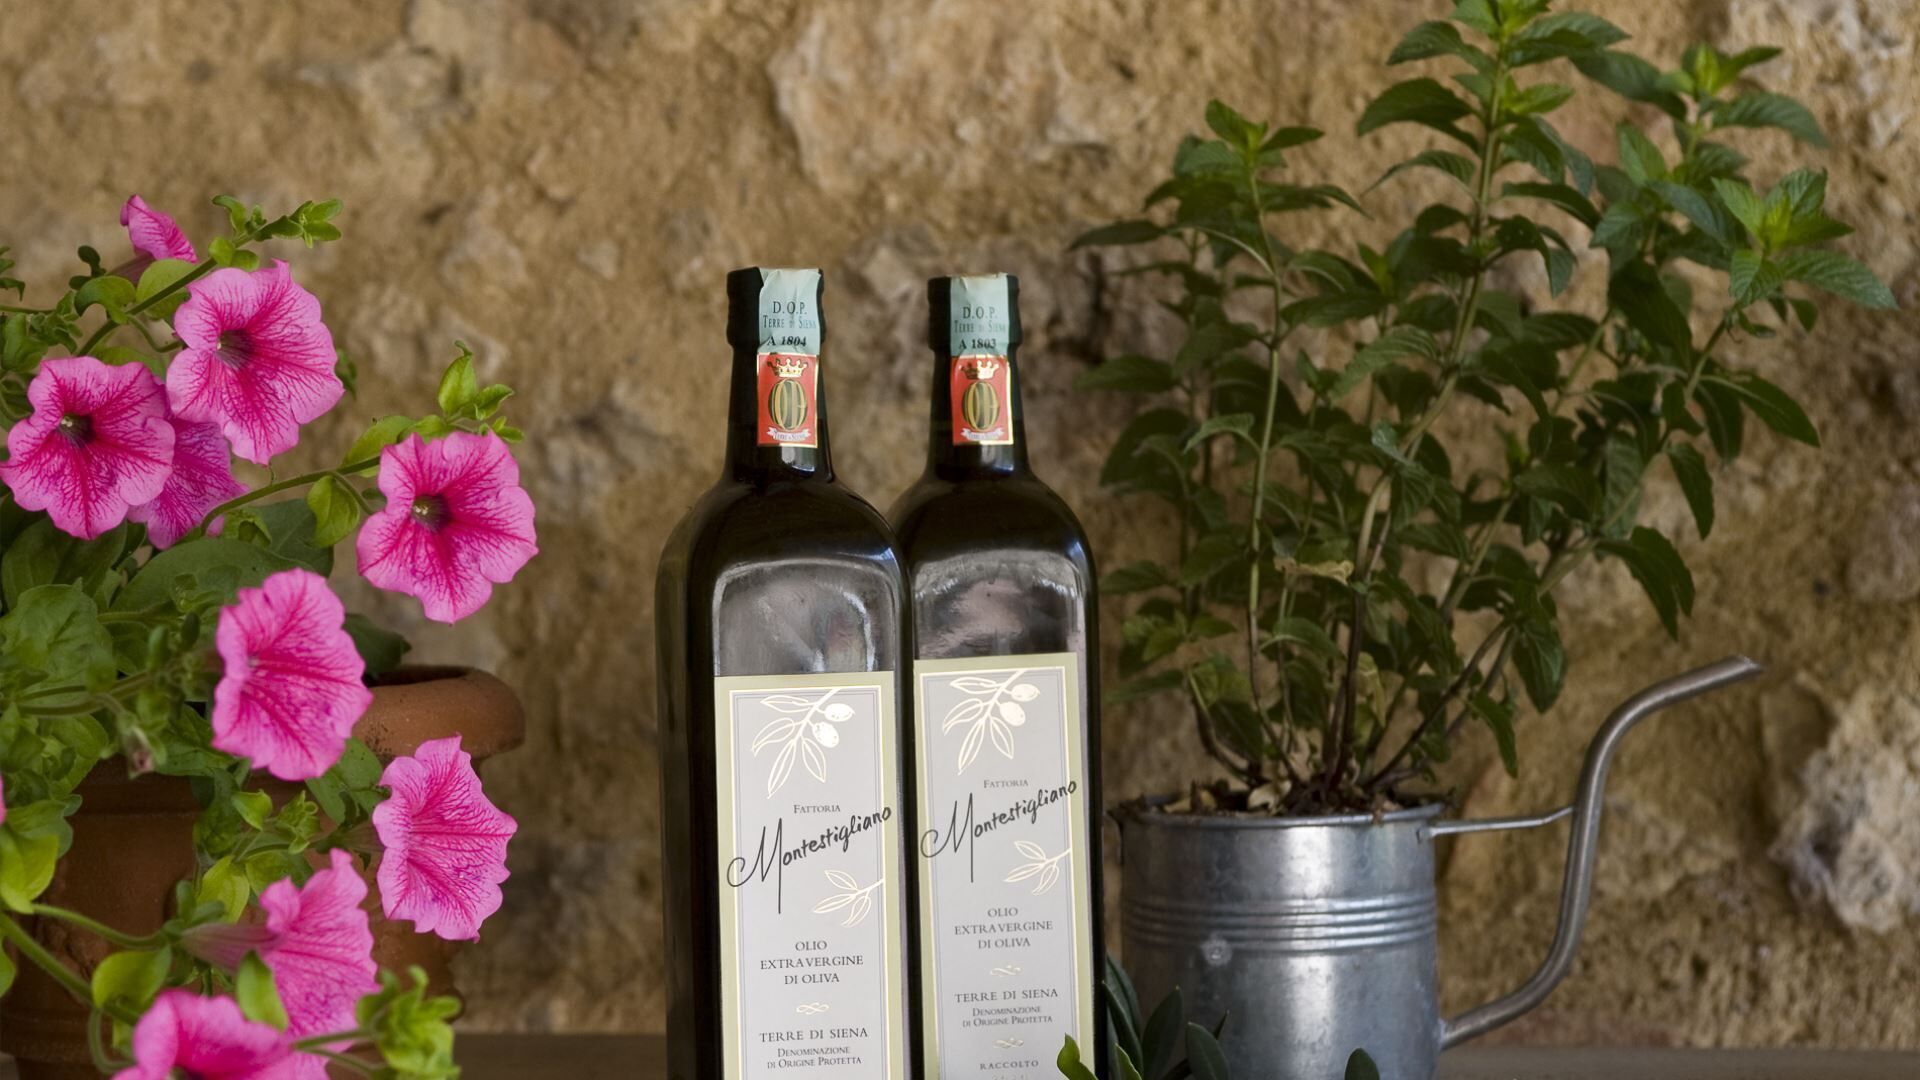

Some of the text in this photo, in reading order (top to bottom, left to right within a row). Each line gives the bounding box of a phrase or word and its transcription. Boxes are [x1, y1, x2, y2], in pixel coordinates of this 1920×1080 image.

[773, 301, 807, 315] D.O.P.
[963, 306, 998, 319] D.O.P.
[763, 315, 785, 328] TERRE
[767, 336, 807, 347] A 1804
[959, 338, 967, 349] A
[983, 779, 1029, 789] FATTORIA
[793, 804, 841, 814] FATTORIA
[921, 781, 1077, 883] Montestigliano
[727, 807, 892, 914] Montestigliano
[987, 907, 1019, 918] OLIO
[795, 940, 828, 951] OLIO
[978, 937, 1031, 949] DI OLIVA
[784, 972, 840, 985] DI OLIVA
[954, 988, 1058, 1003] TERRE DI SIENA
[972, 1005, 1042, 1017] DENOMINAZIONE
[962, 1015, 1053, 1028] DI ORIGINE PROTETTA
[759, 1027, 868, 1043] TERRE DI SIENA
[777, 1046, 850, 1058] DENOMINAZIONE
[767, 1056, 862, 1070] DI ORIGINE PROTETTA
[980, 1060, 1039, 1071] RACCOLTO
